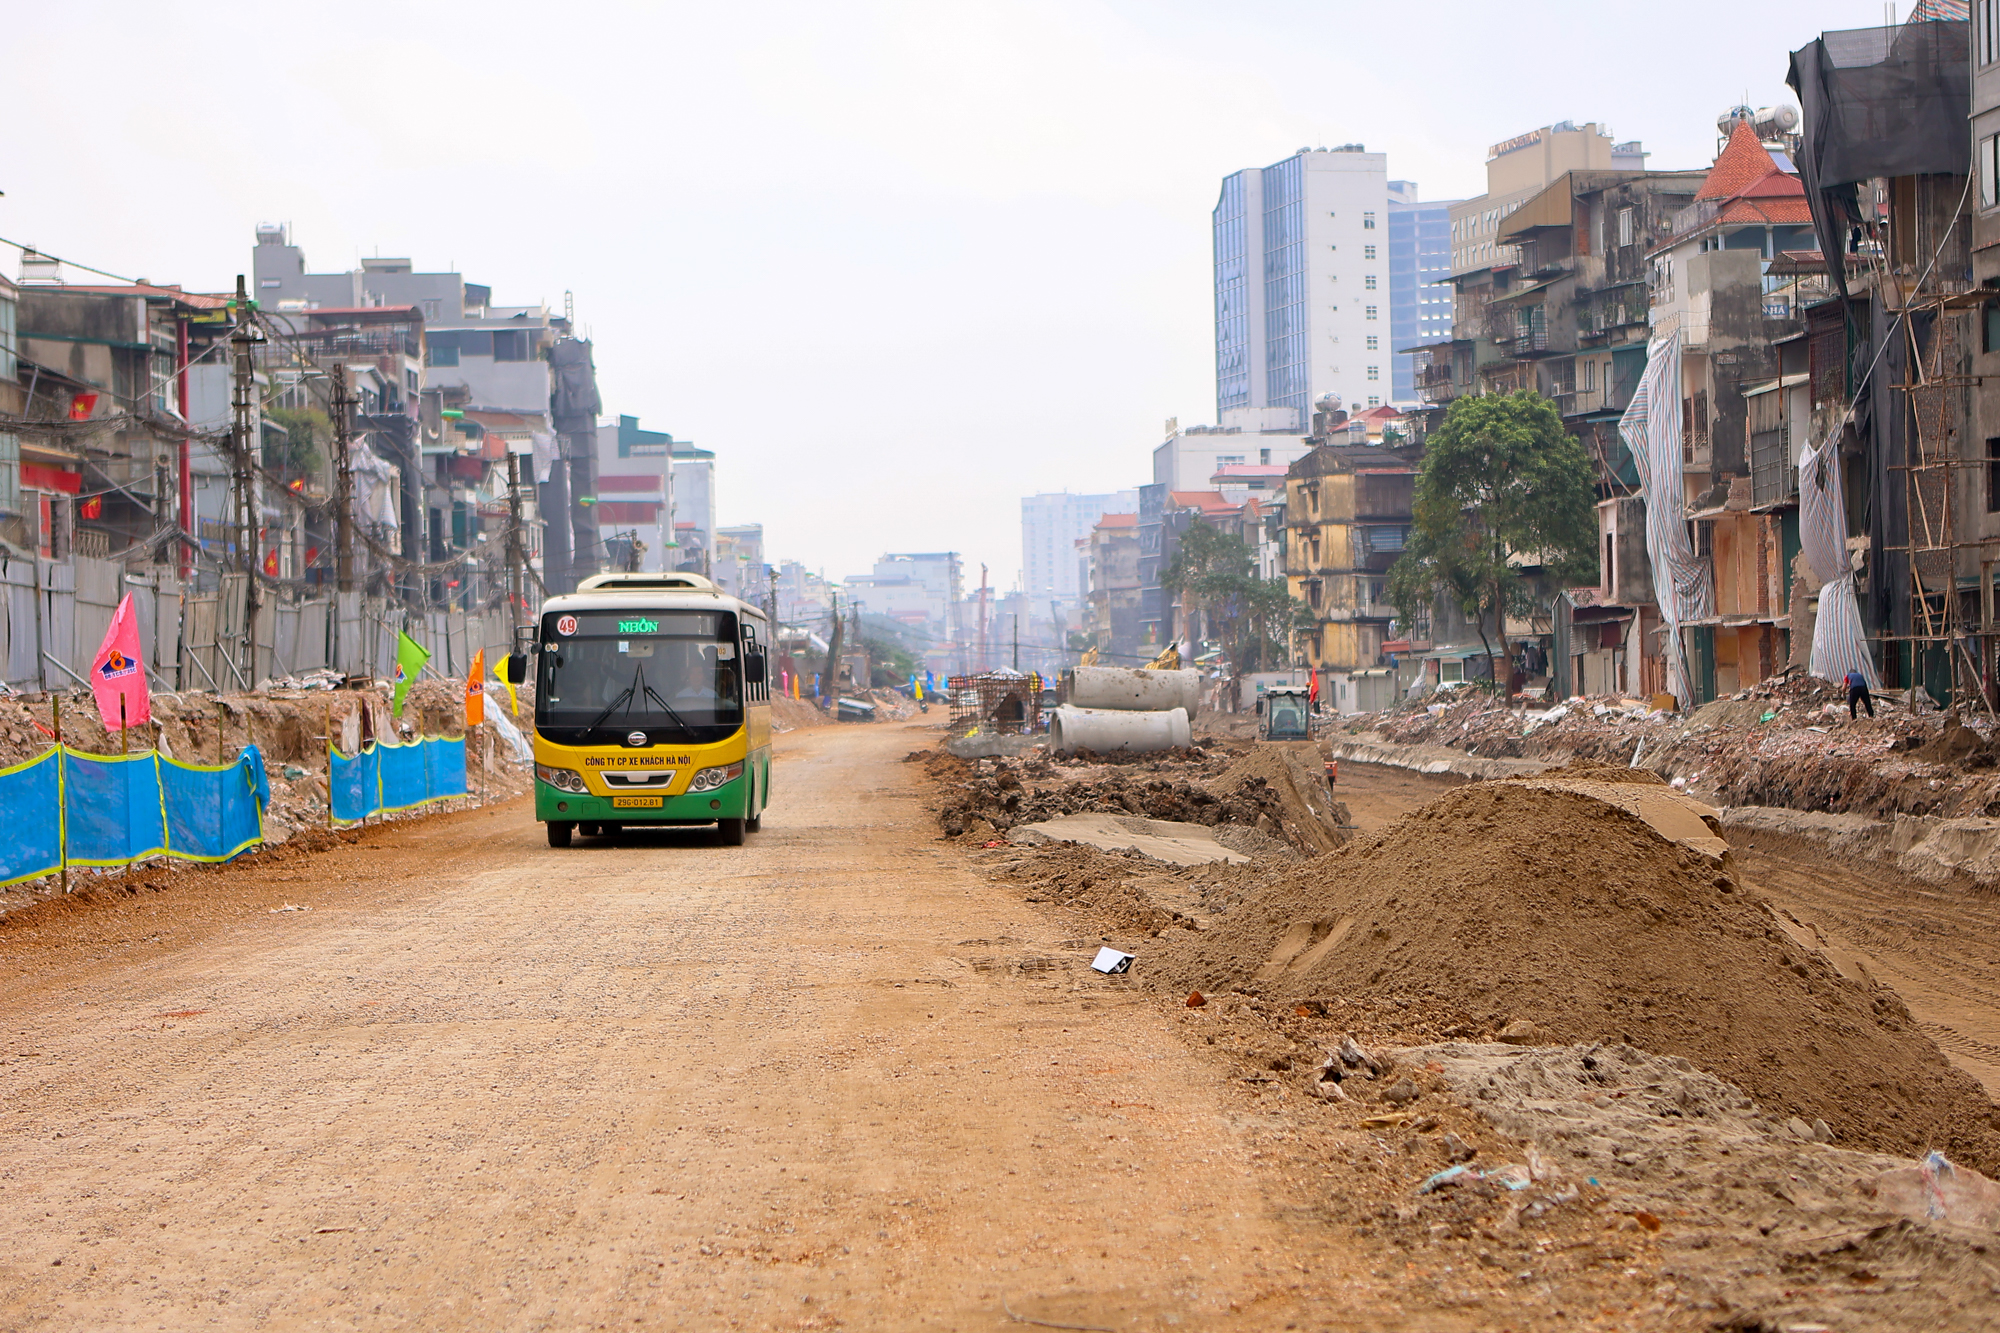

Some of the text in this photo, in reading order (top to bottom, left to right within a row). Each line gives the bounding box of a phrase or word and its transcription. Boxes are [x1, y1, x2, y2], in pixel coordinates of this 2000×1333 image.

[560, 619, 576, 633] 49
[585, 754, 691, 767] CÔNG TY CP XE KHÁCH HÀ NỘI
